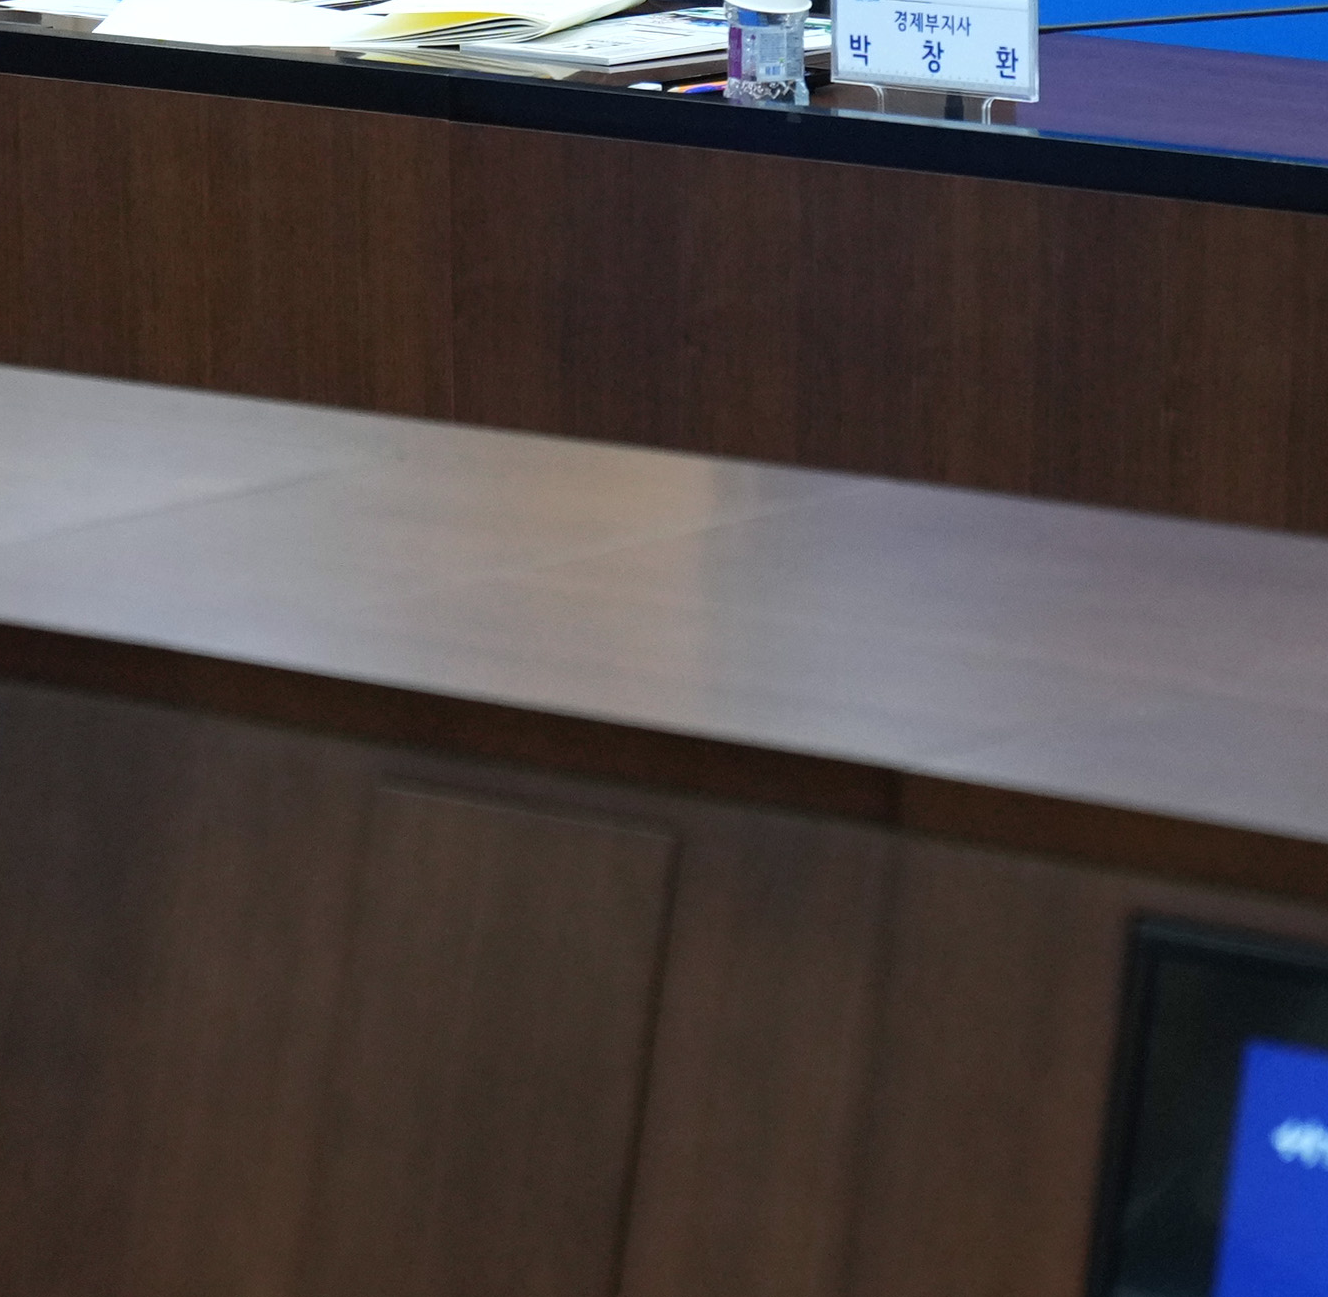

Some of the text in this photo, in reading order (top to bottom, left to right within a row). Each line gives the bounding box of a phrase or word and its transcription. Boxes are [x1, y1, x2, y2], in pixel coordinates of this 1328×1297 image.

[894, 11, 972, 37] 경제부지사
[850, 34, 1019, 79] 박 창 환
